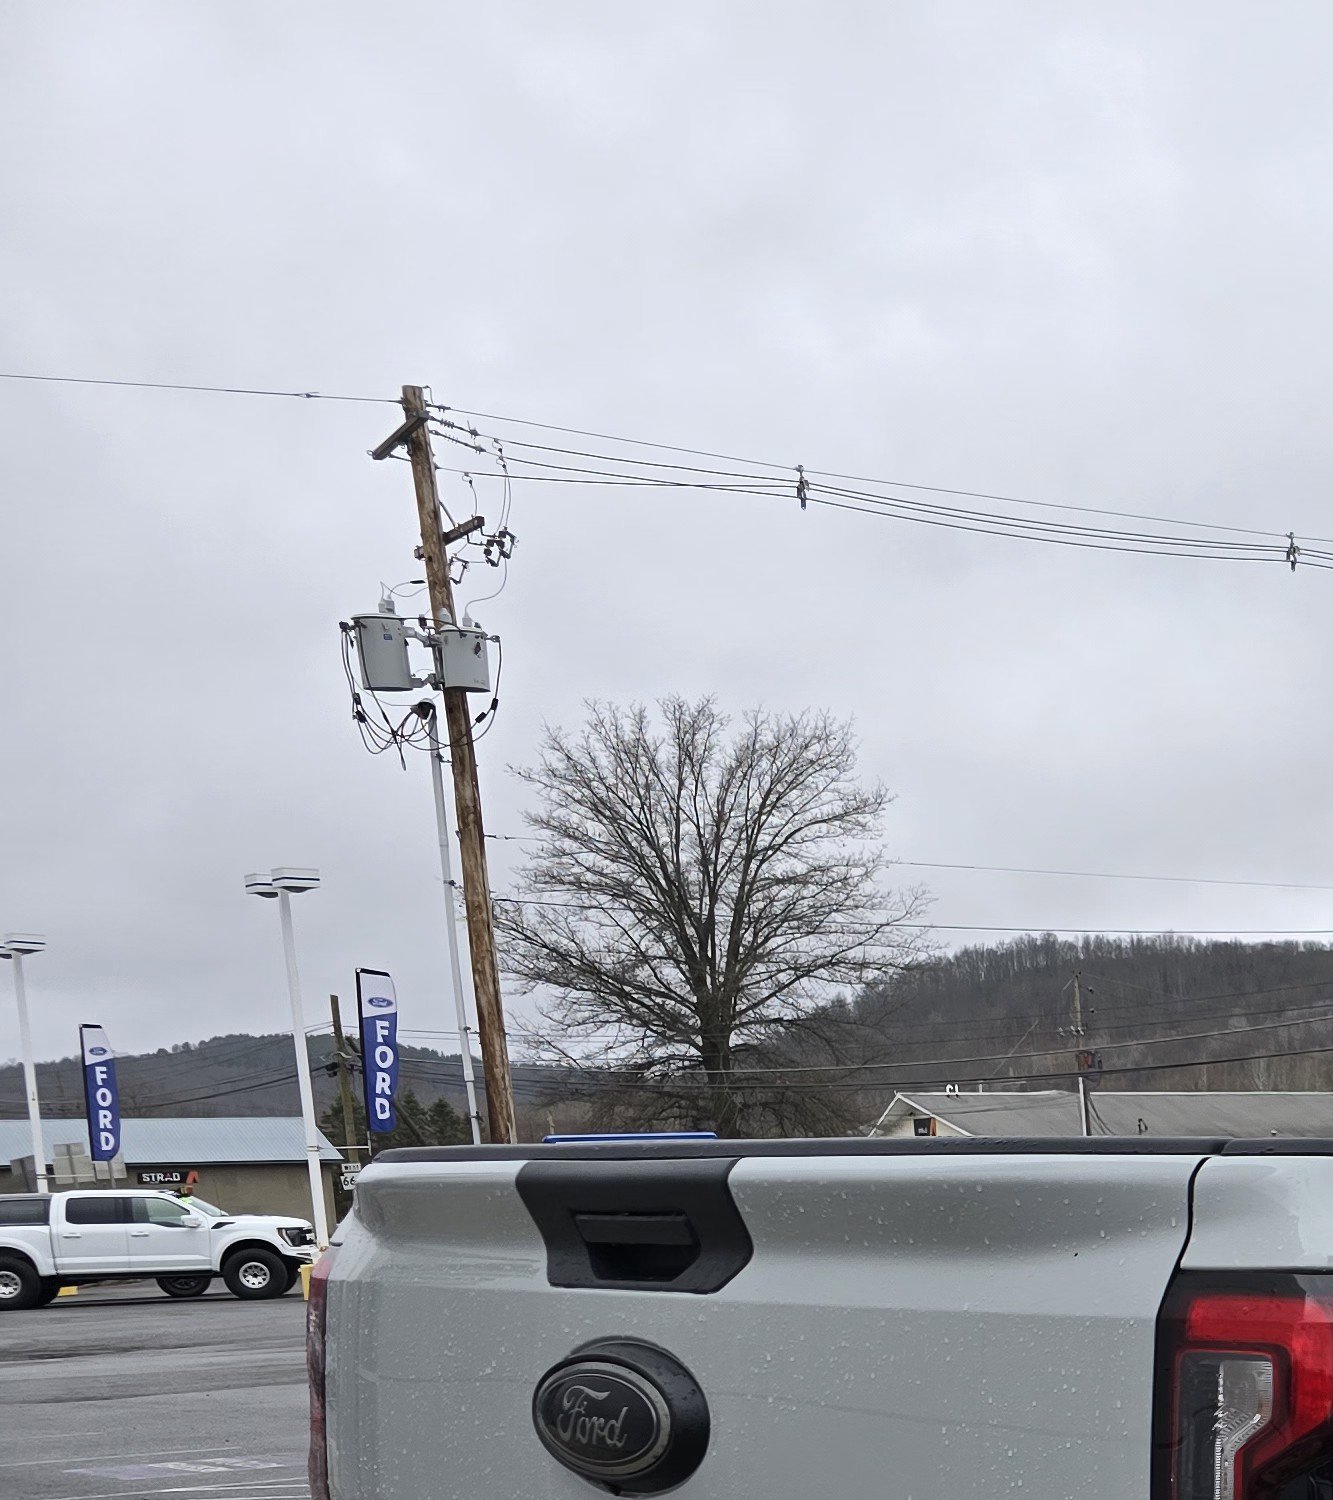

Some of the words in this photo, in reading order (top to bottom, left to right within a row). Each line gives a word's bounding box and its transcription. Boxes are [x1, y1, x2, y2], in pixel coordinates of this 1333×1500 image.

[94, 1066, 116, 1151] FORD
[374, 1019, 395, 1120] FORD
[556, 1385, 629, 1448] Ford
